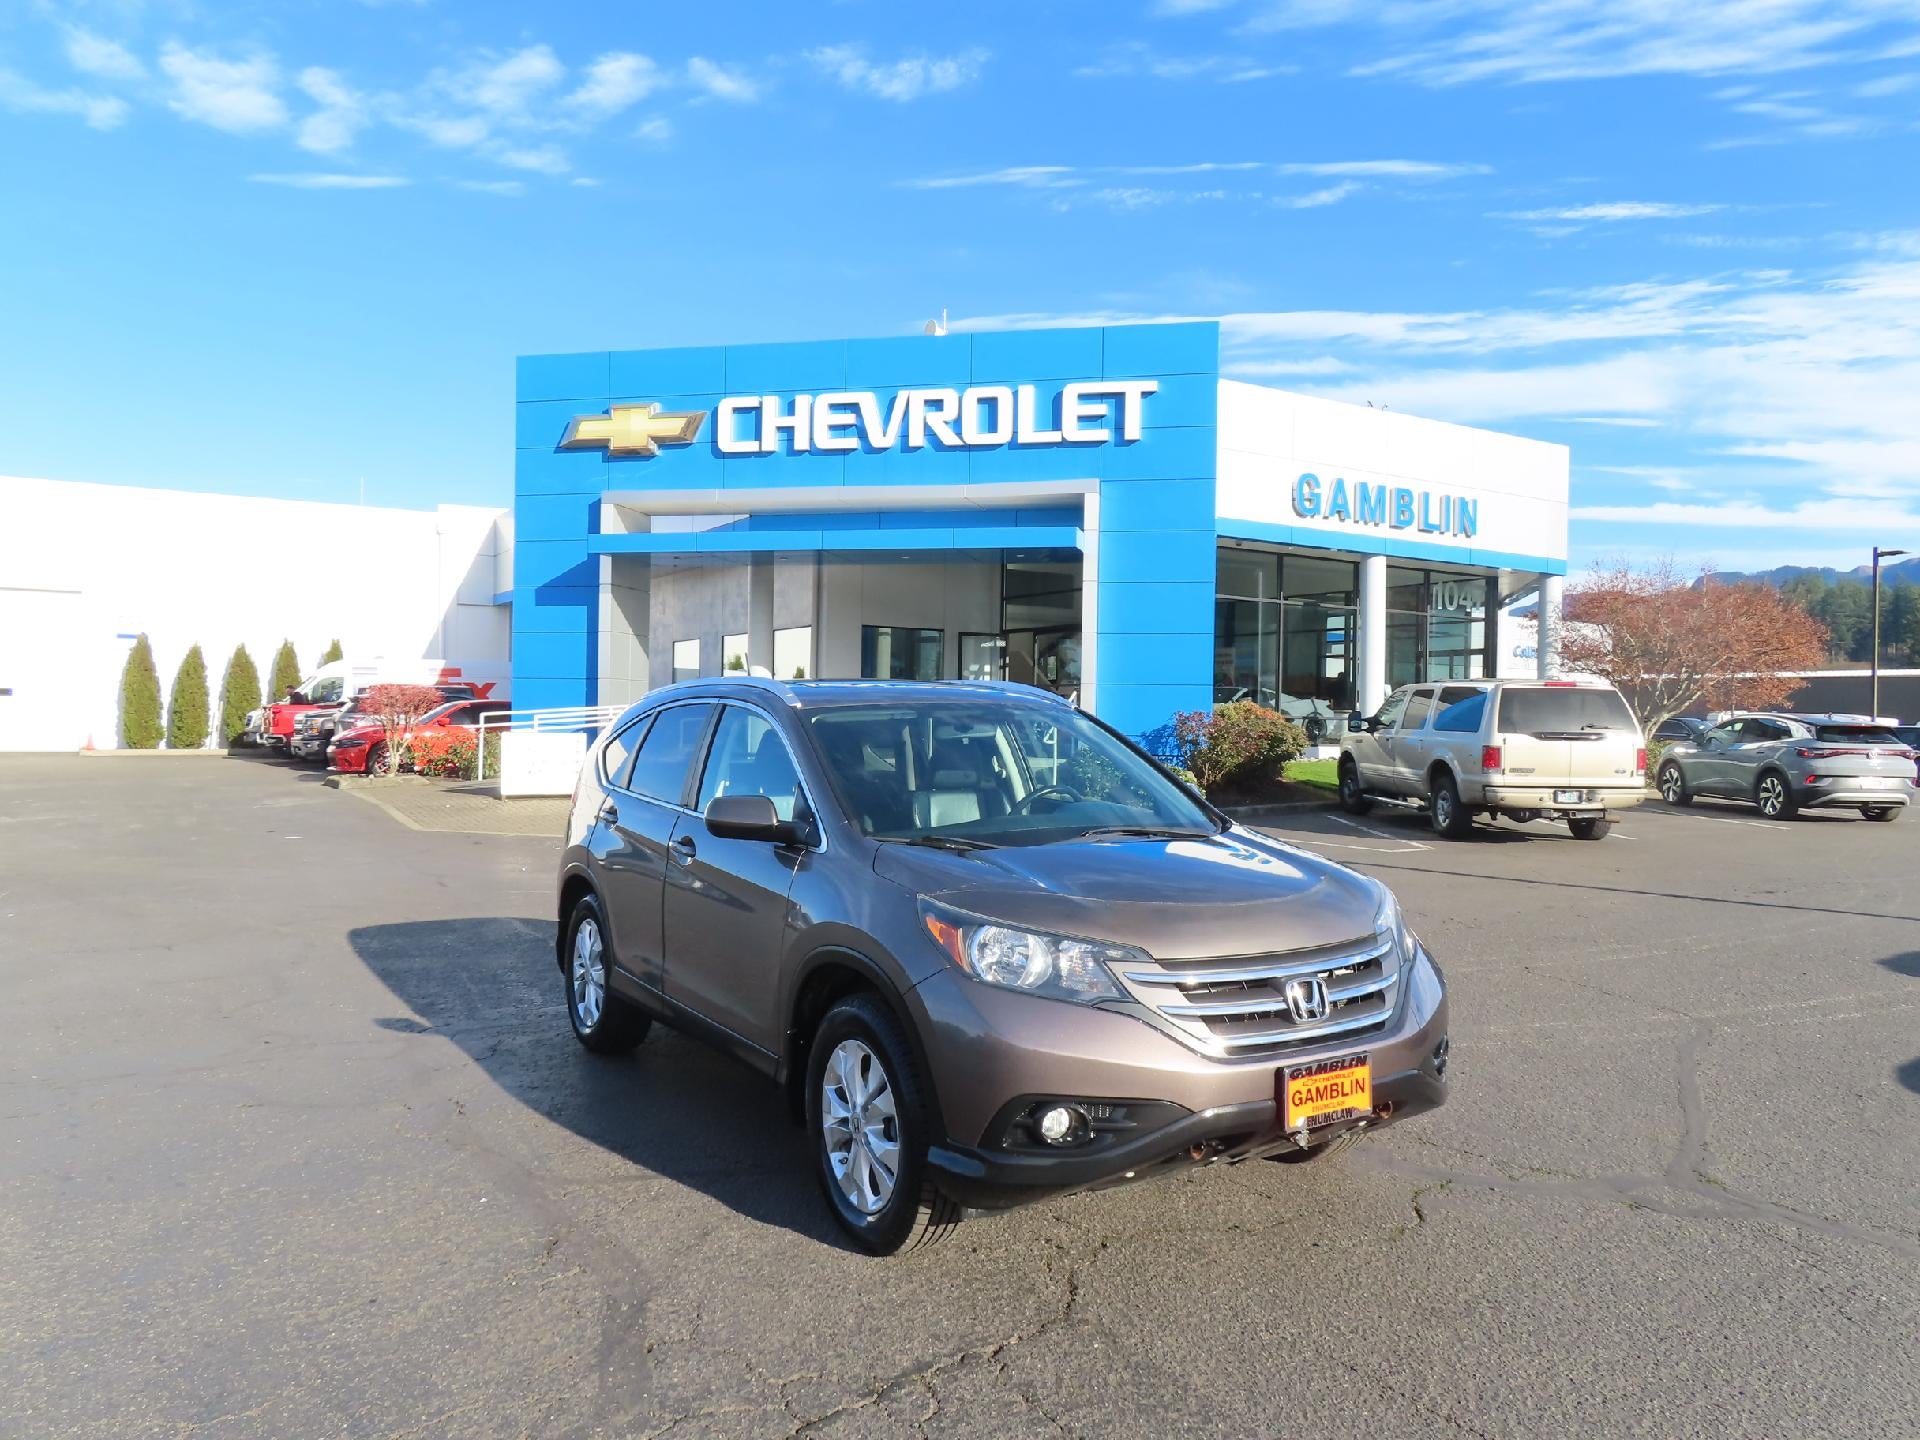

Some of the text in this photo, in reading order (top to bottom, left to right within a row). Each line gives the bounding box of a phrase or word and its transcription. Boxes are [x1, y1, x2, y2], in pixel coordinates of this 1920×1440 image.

[716, 380, 1158, 454] CHEVROLET
[1292, 473, 1478, 538] GAMBLIN
[1290, 1055, 1367, 1080] GAMBLIN
[1292, 1077, 1365, 1107] GAMBLIN
